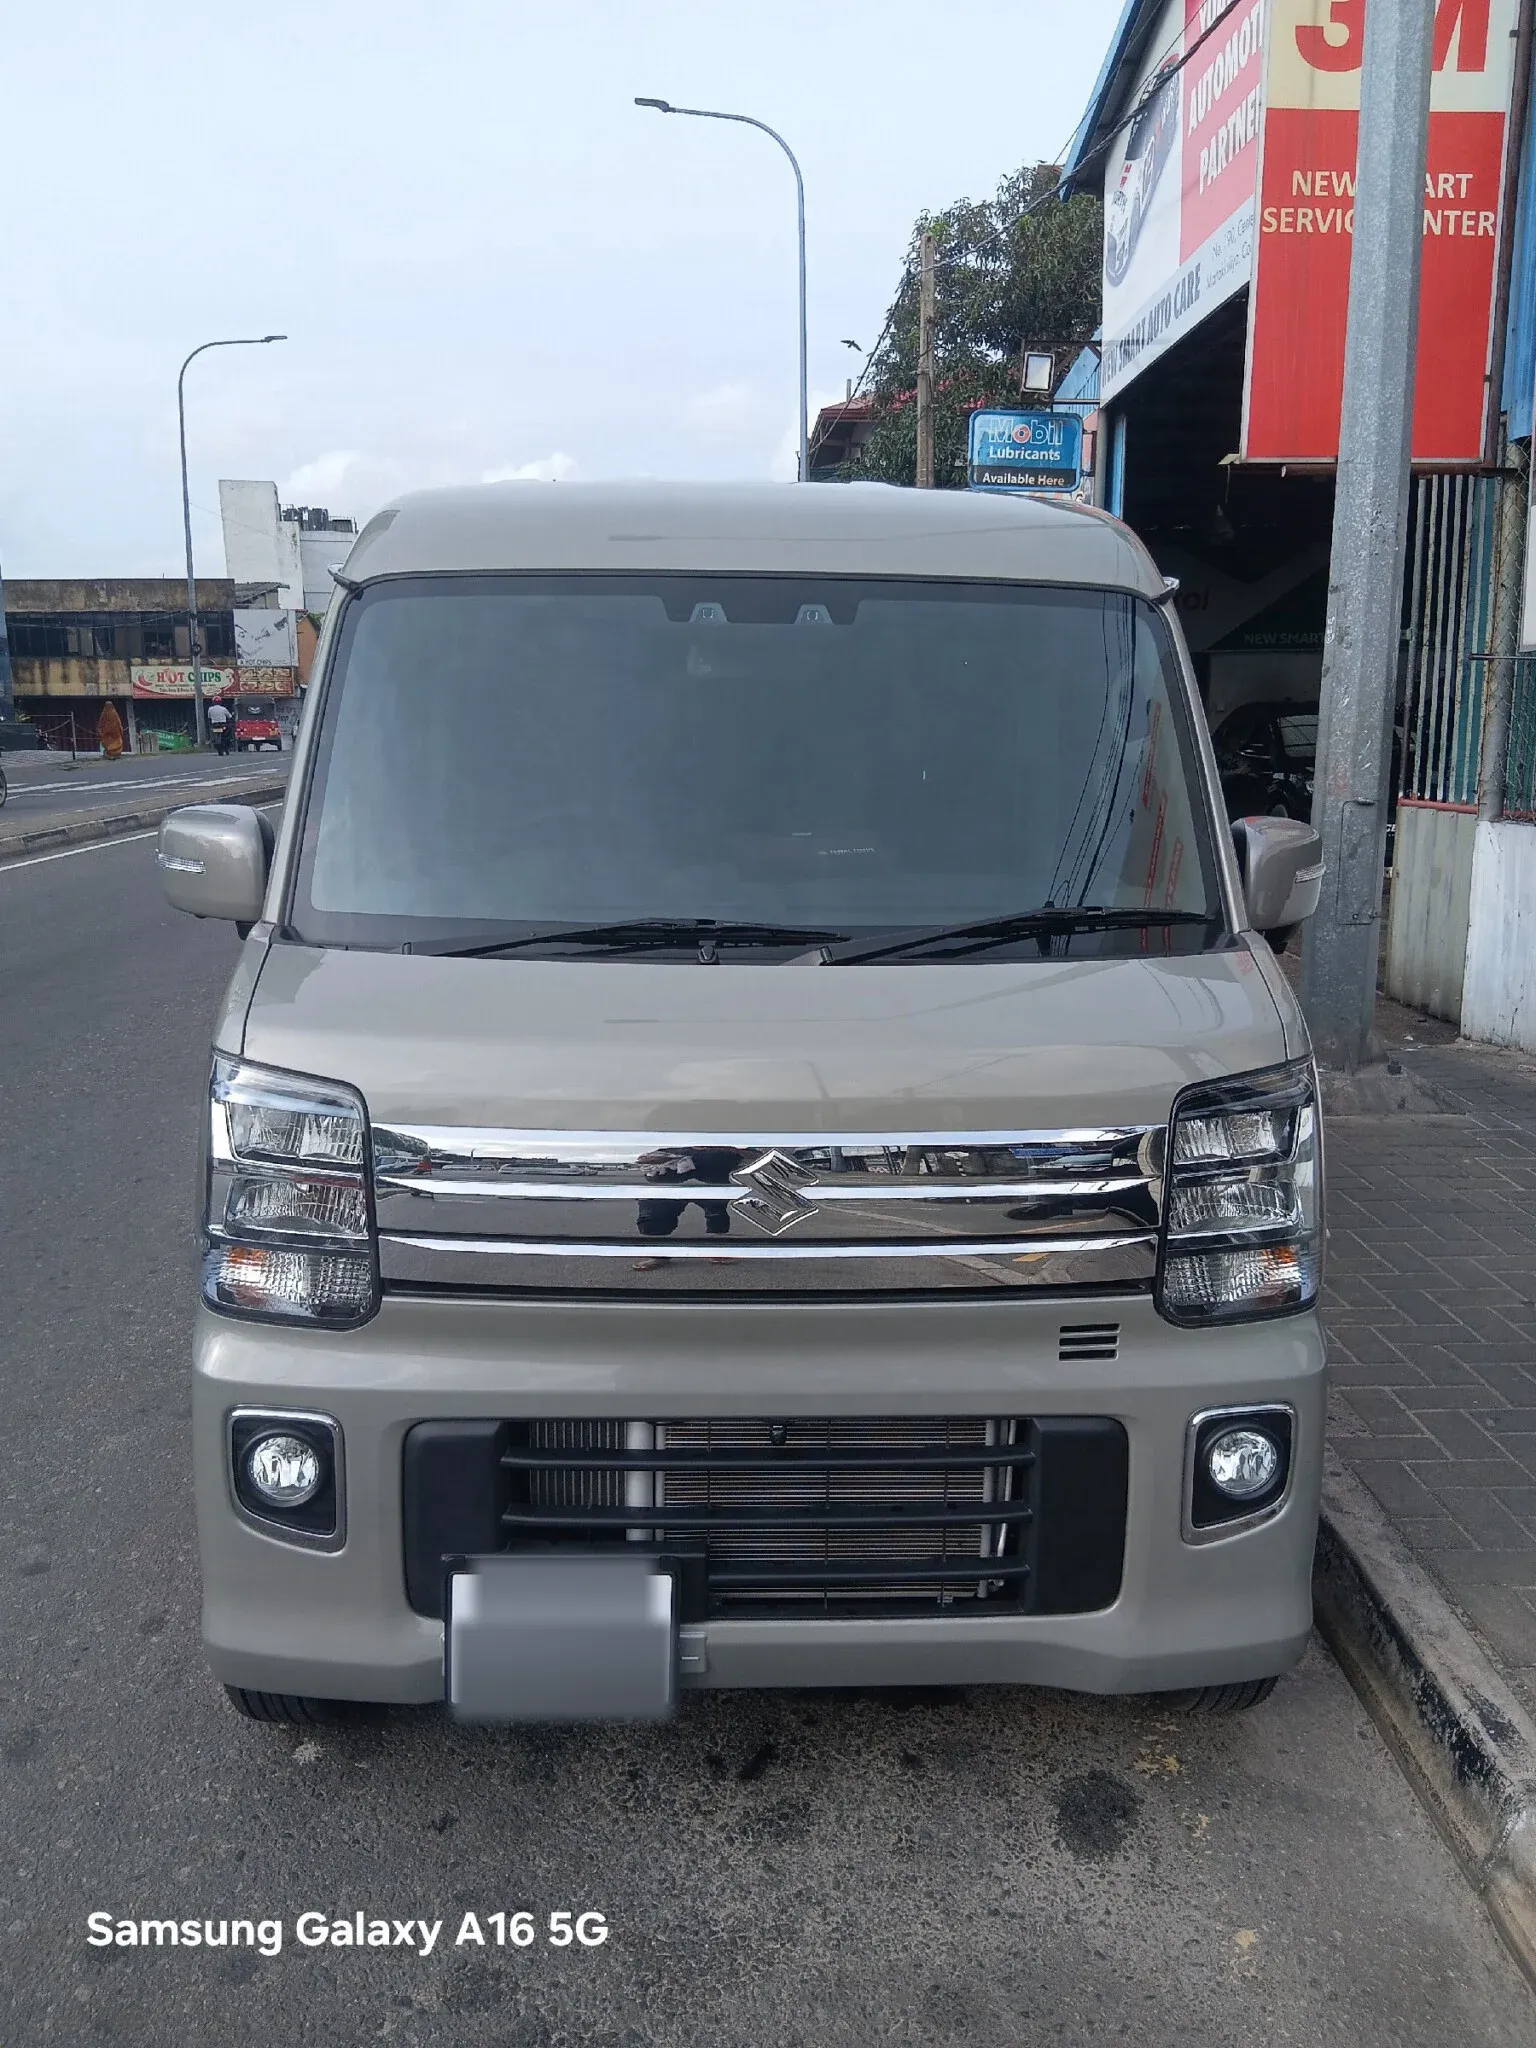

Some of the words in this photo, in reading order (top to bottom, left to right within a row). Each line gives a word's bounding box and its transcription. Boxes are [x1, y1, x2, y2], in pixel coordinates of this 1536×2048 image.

[1292, 170, 1356, 196] NEW
[1261, 207, 1355, 234] SERVIC
[1423, 210, 1495, 236] NTER
[1119, 316, 1146, 372] SMART
[1147, 292, 1172, 345] AUTO
[1174, 263, 1201, 320] CARE
[988, 418, 1064, 446] Mobil
[989, 445, 1061, 461] Lubricants
[982, 472, 1035, 485] Available
[1037, 474, 1065, 486] Here
